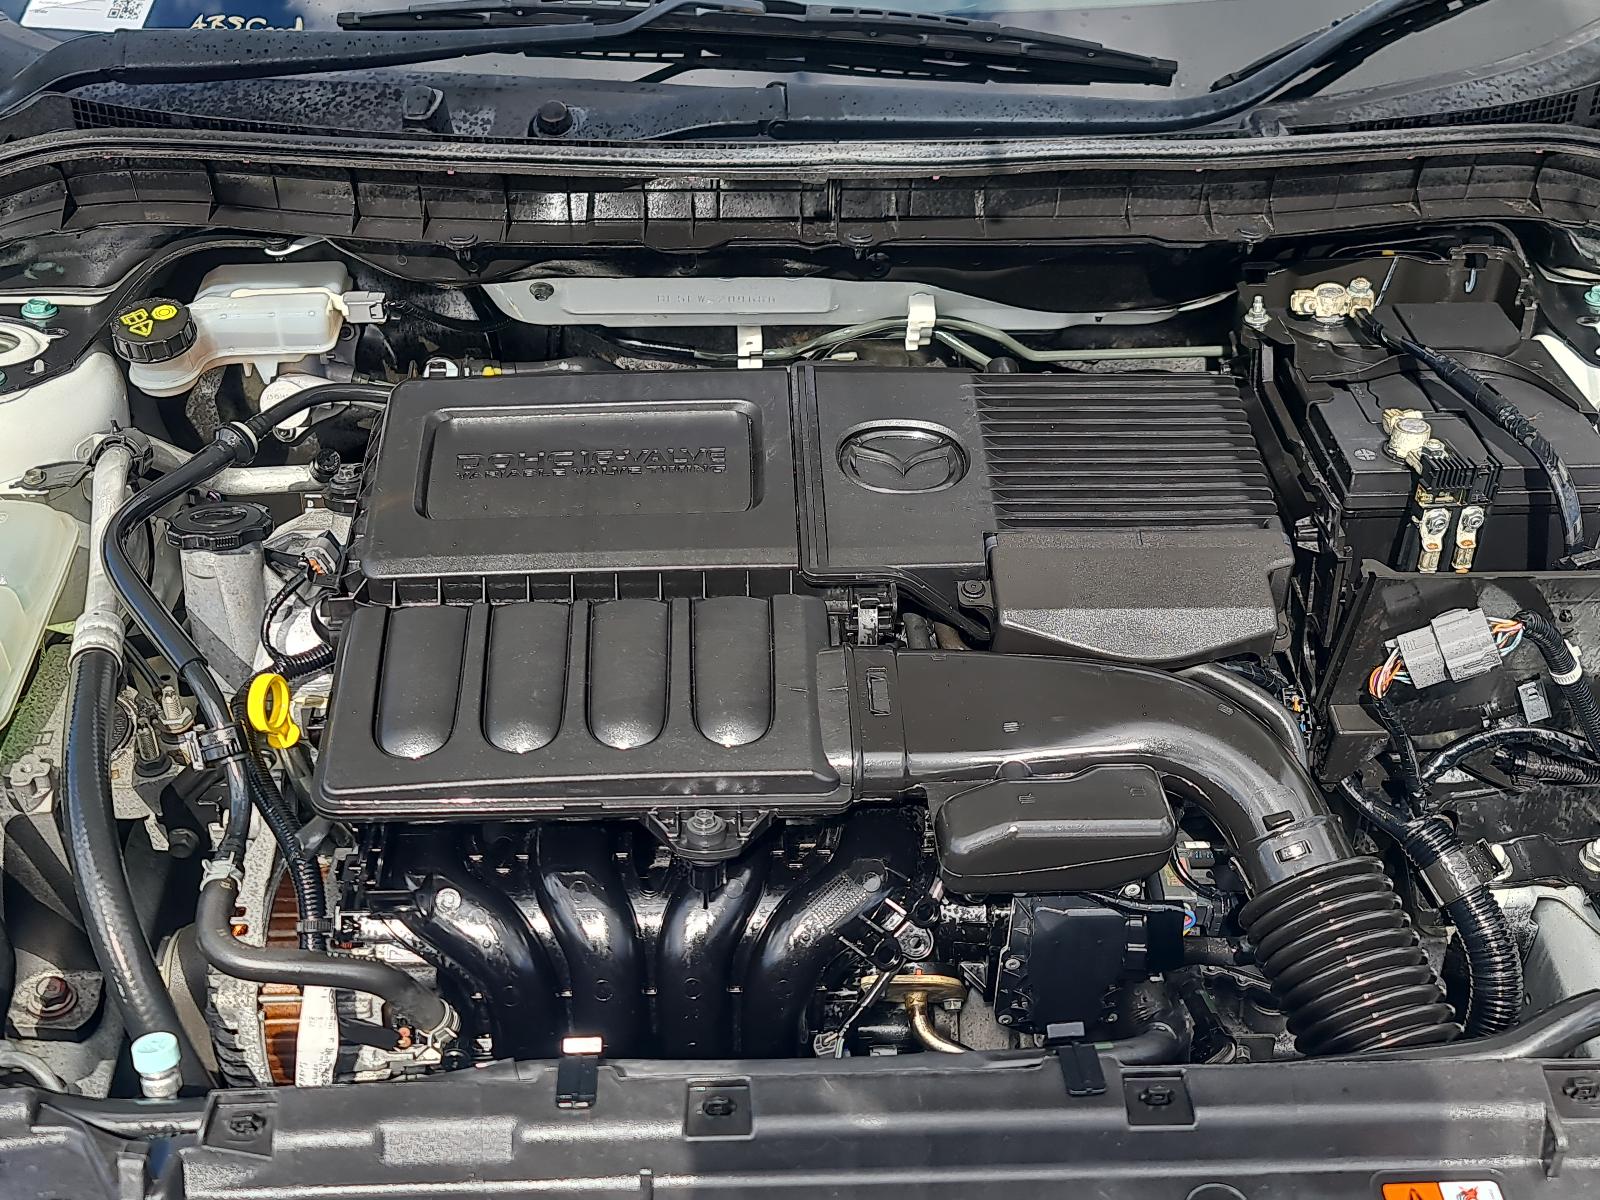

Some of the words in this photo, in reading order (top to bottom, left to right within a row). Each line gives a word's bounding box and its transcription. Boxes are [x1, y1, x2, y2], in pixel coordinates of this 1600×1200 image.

[456, 467, 566, 480] VARIABLE
[571, 465, 642, 477] VALVE
[646, 463, 726, 474] TIMING
